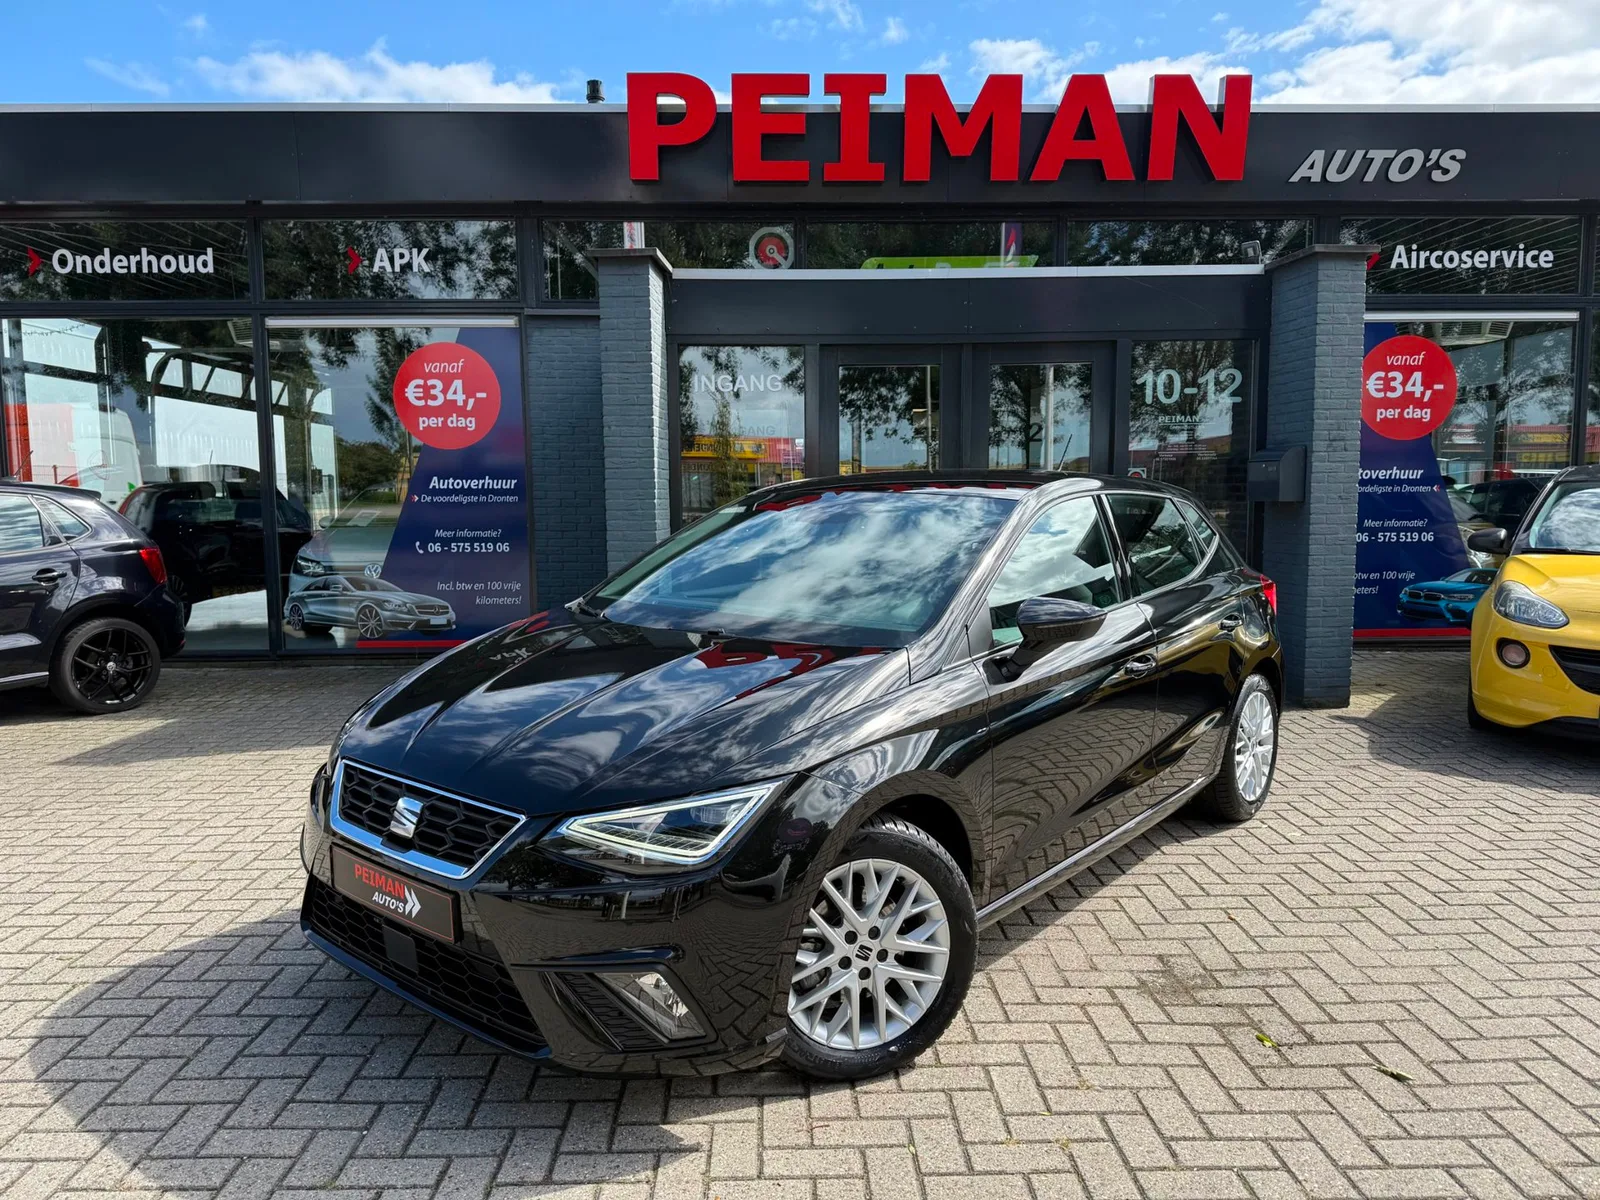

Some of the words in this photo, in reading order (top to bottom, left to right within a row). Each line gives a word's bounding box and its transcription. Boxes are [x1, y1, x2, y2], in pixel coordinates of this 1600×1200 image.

[627, 72, 1253, 184] PEIMAN
[1288, 148, 1467, 183] AUTO'S
[51, 247, 215, 274] Onderhoud
[372, 247, 431, 273] APK
[1390, 243, 1555, 269] Aircoservice
[424, 358, 465, 373] vanaf
[1386, 351, 1426, 366] vanaf
[693, 374, 782, 392] INGANG
[1135, 368, 1243, 405] 10-12
[1366, 371, 1444, 403] €34,-
[405, 378, 487, 411] €34,-
[1158, 415, 1201, 423] PEIMAN
[1376, 407, 1401, 422] per
[1403, 405, 1431, 422] dag
[418, 416, 444, 431] per
[447, 413, 476, 431] dag
[1358, 466, 1424, 480] toverhuur
[429, 475, 518, 490] Autoverhuur
[1357, 484, 1393, 495] ordeligste
[1393, 484, 1401, 493] in
[1401, 484, 1432, 493] Dronten
[420, 494, 432, 503] De
[432, 494, 479, 505] voordeligste
[479, 494, 487, 503] in
[488, 494, 519, 503] Dronten
[1363, 519, 1383, 528] Meer
[1383, 518, 1428, 528] informatie?
[434, 529, 456, 538] Meer
[456, 528, 502, 538] informatie?
[1356, 532, 1369, 543] 06
[1377, 532, 1397, 543] 575
[1399, 532, 1419, 542] 519
[1421, 532, 1434, 542] 06
[427, 542, 442, 553] 06
[450, 542, 471, 553] 575
[473, 542, 494, 553] 519
[496, 542, 510, 553] 06
[1382, 571, 1397, 580] 100
[1398, 571, 1416, 581] vrije
[437, 581, 455, 591] Incl.
[455, 581, 473, 591] btw
[475, 583, 485, 591] en
[487, 581, 502, 591] 100
[503, 581, 522, 592] vrije
[1354, 585, 1379, 595] eters!
[475, 595, 522, 605] kilometers!
[354, 863, 405, 900] PEIMAN
[372, 891, 405, 914] AUTO'S
